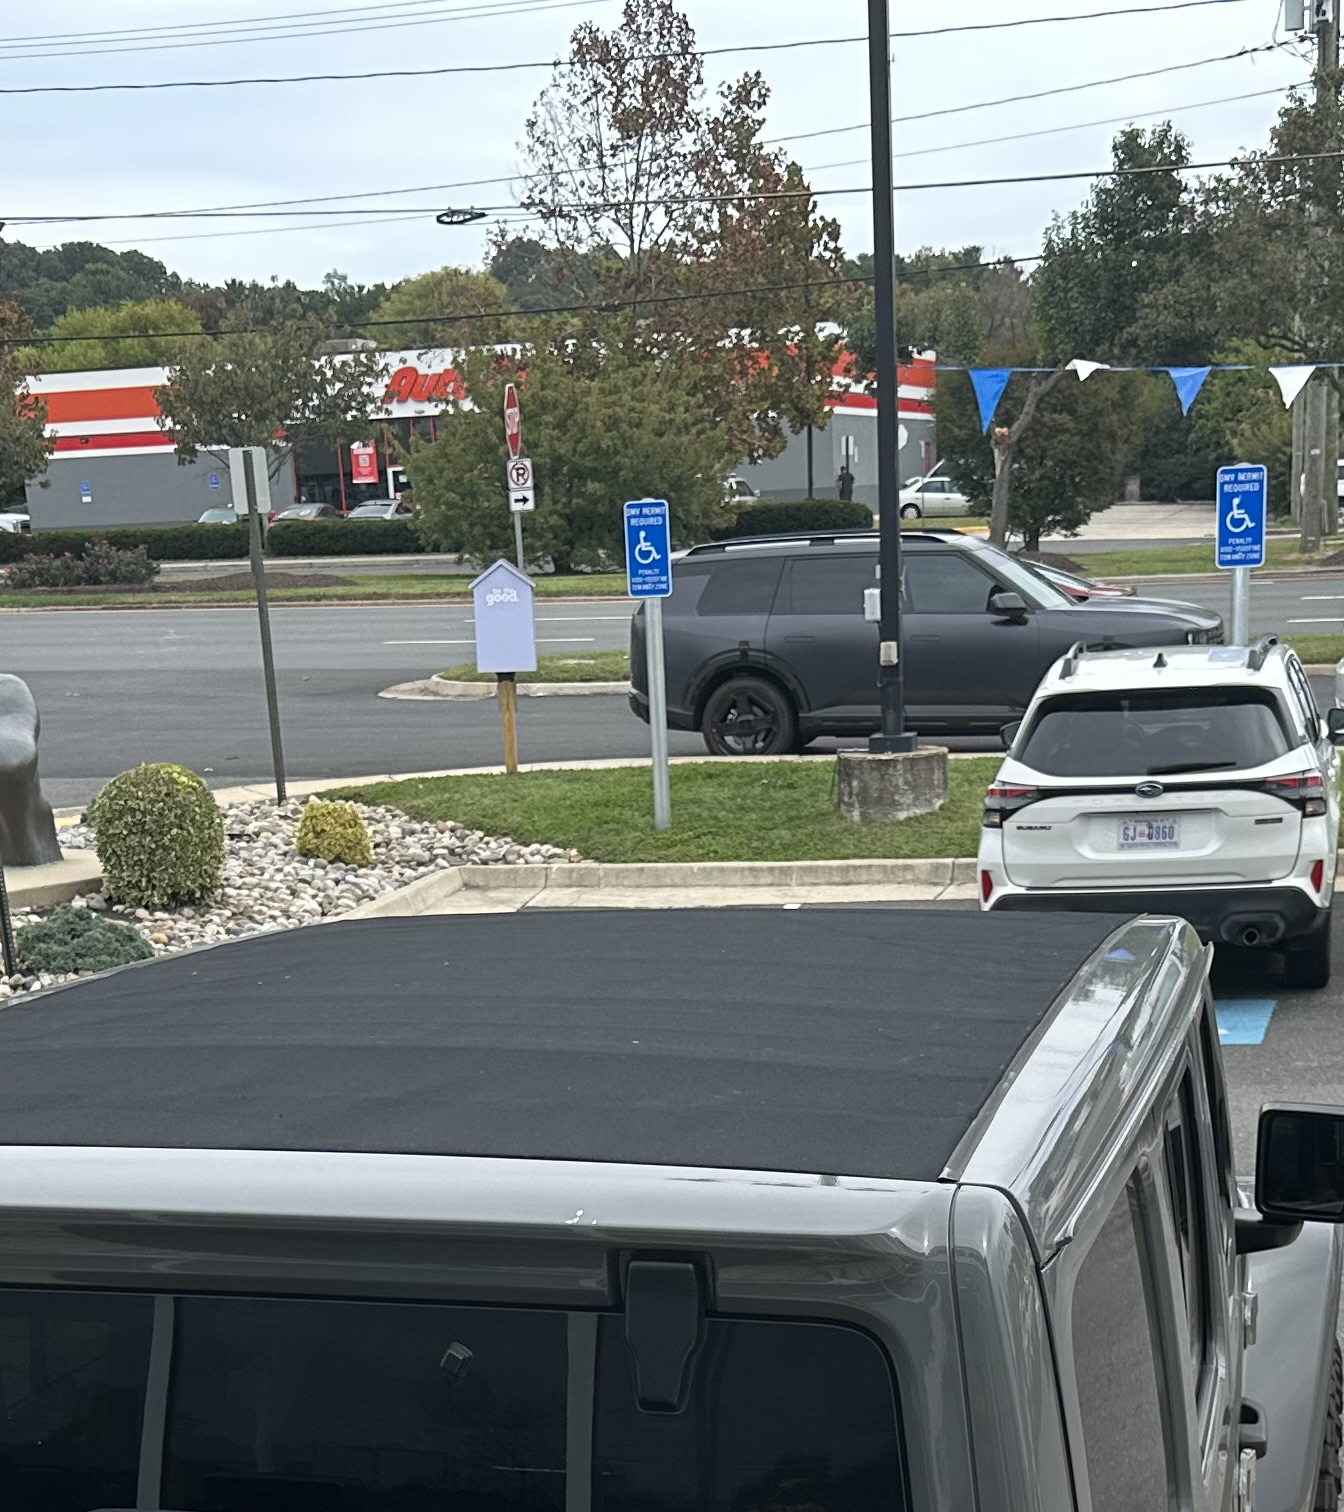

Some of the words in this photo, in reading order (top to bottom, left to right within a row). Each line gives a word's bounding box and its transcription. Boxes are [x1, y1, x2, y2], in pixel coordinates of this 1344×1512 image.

[1237, 472, 1264, 481] PERMIT
[1224, 483, 1260, 492] REQUIRED
[642, 506, 665, 515] PERMIT
[630, 517, 663, 526] REQUIRED
